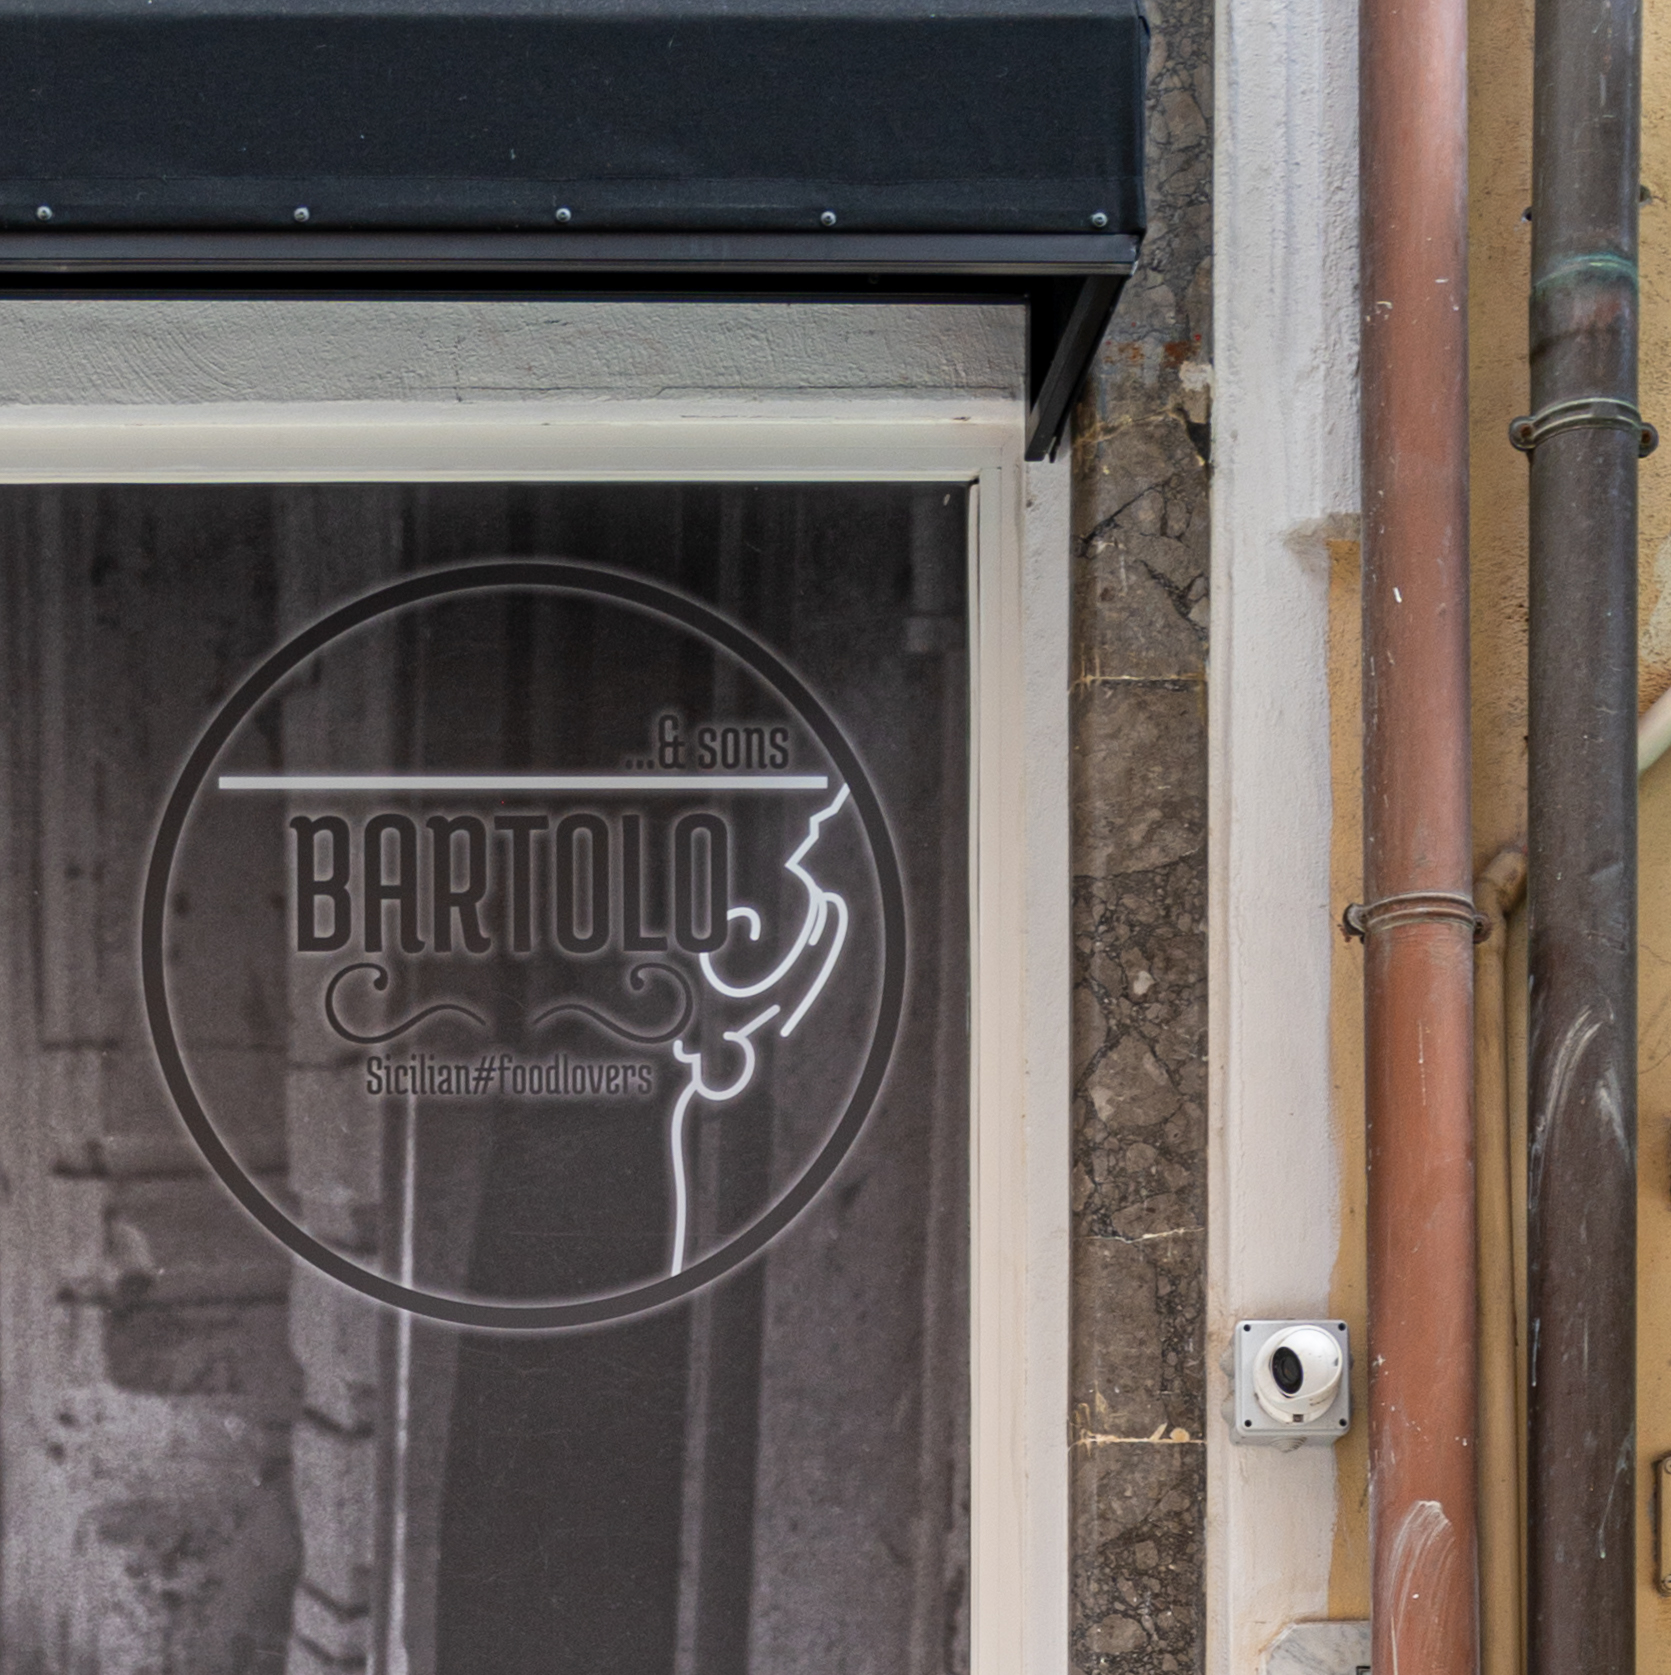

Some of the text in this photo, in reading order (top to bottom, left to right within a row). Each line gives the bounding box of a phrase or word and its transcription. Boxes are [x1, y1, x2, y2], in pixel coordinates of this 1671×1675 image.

[697, 726, 790, 770] sons
[289, 813, 729, 954] BARTOLO
[366, 1054, 653, 1096] Sicilian#foodlovers
